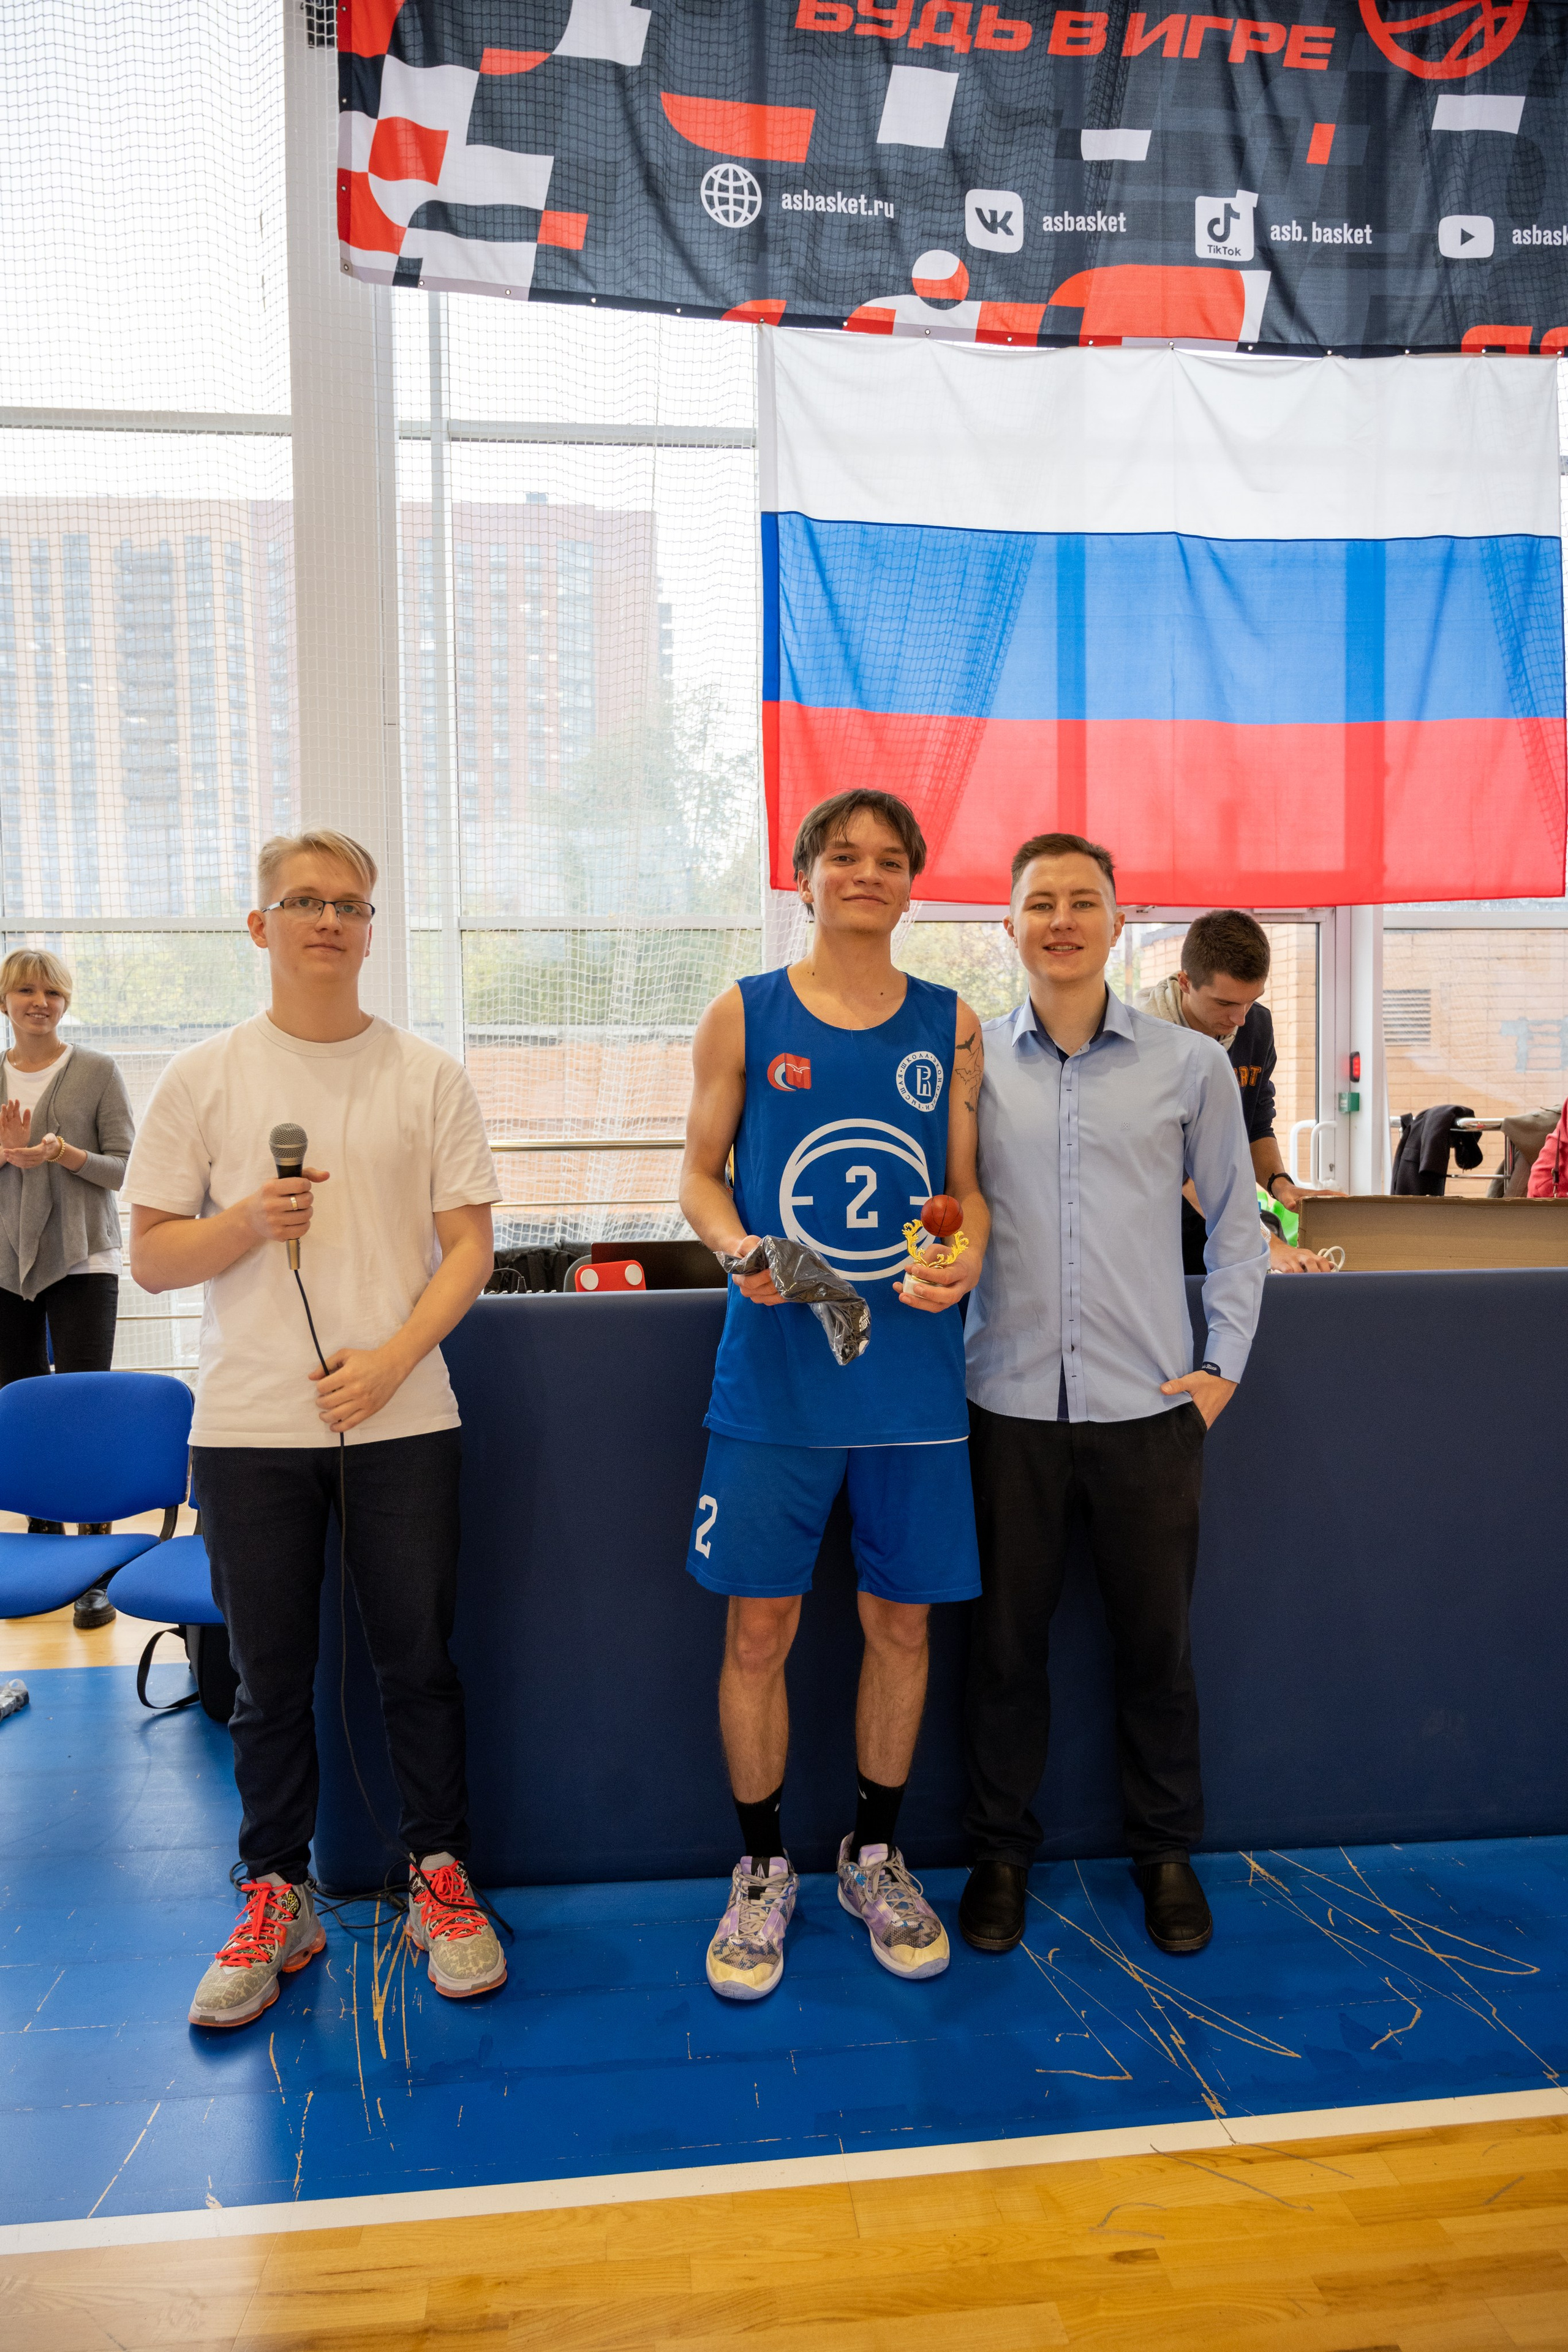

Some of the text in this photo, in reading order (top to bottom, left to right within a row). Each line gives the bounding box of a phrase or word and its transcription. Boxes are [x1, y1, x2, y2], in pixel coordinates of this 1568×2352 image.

[794, 0, 1336, 70] БУДЬ В ИГРЕ
[782, 189, 894, 219] asbasket.ru
[1042, 211, 1126, 233] asbasket
[1207, 244, 1242, 256] TikTok
[845, 1166, 878, 1229] 2
[695, 1494, 718, 1559] 2
